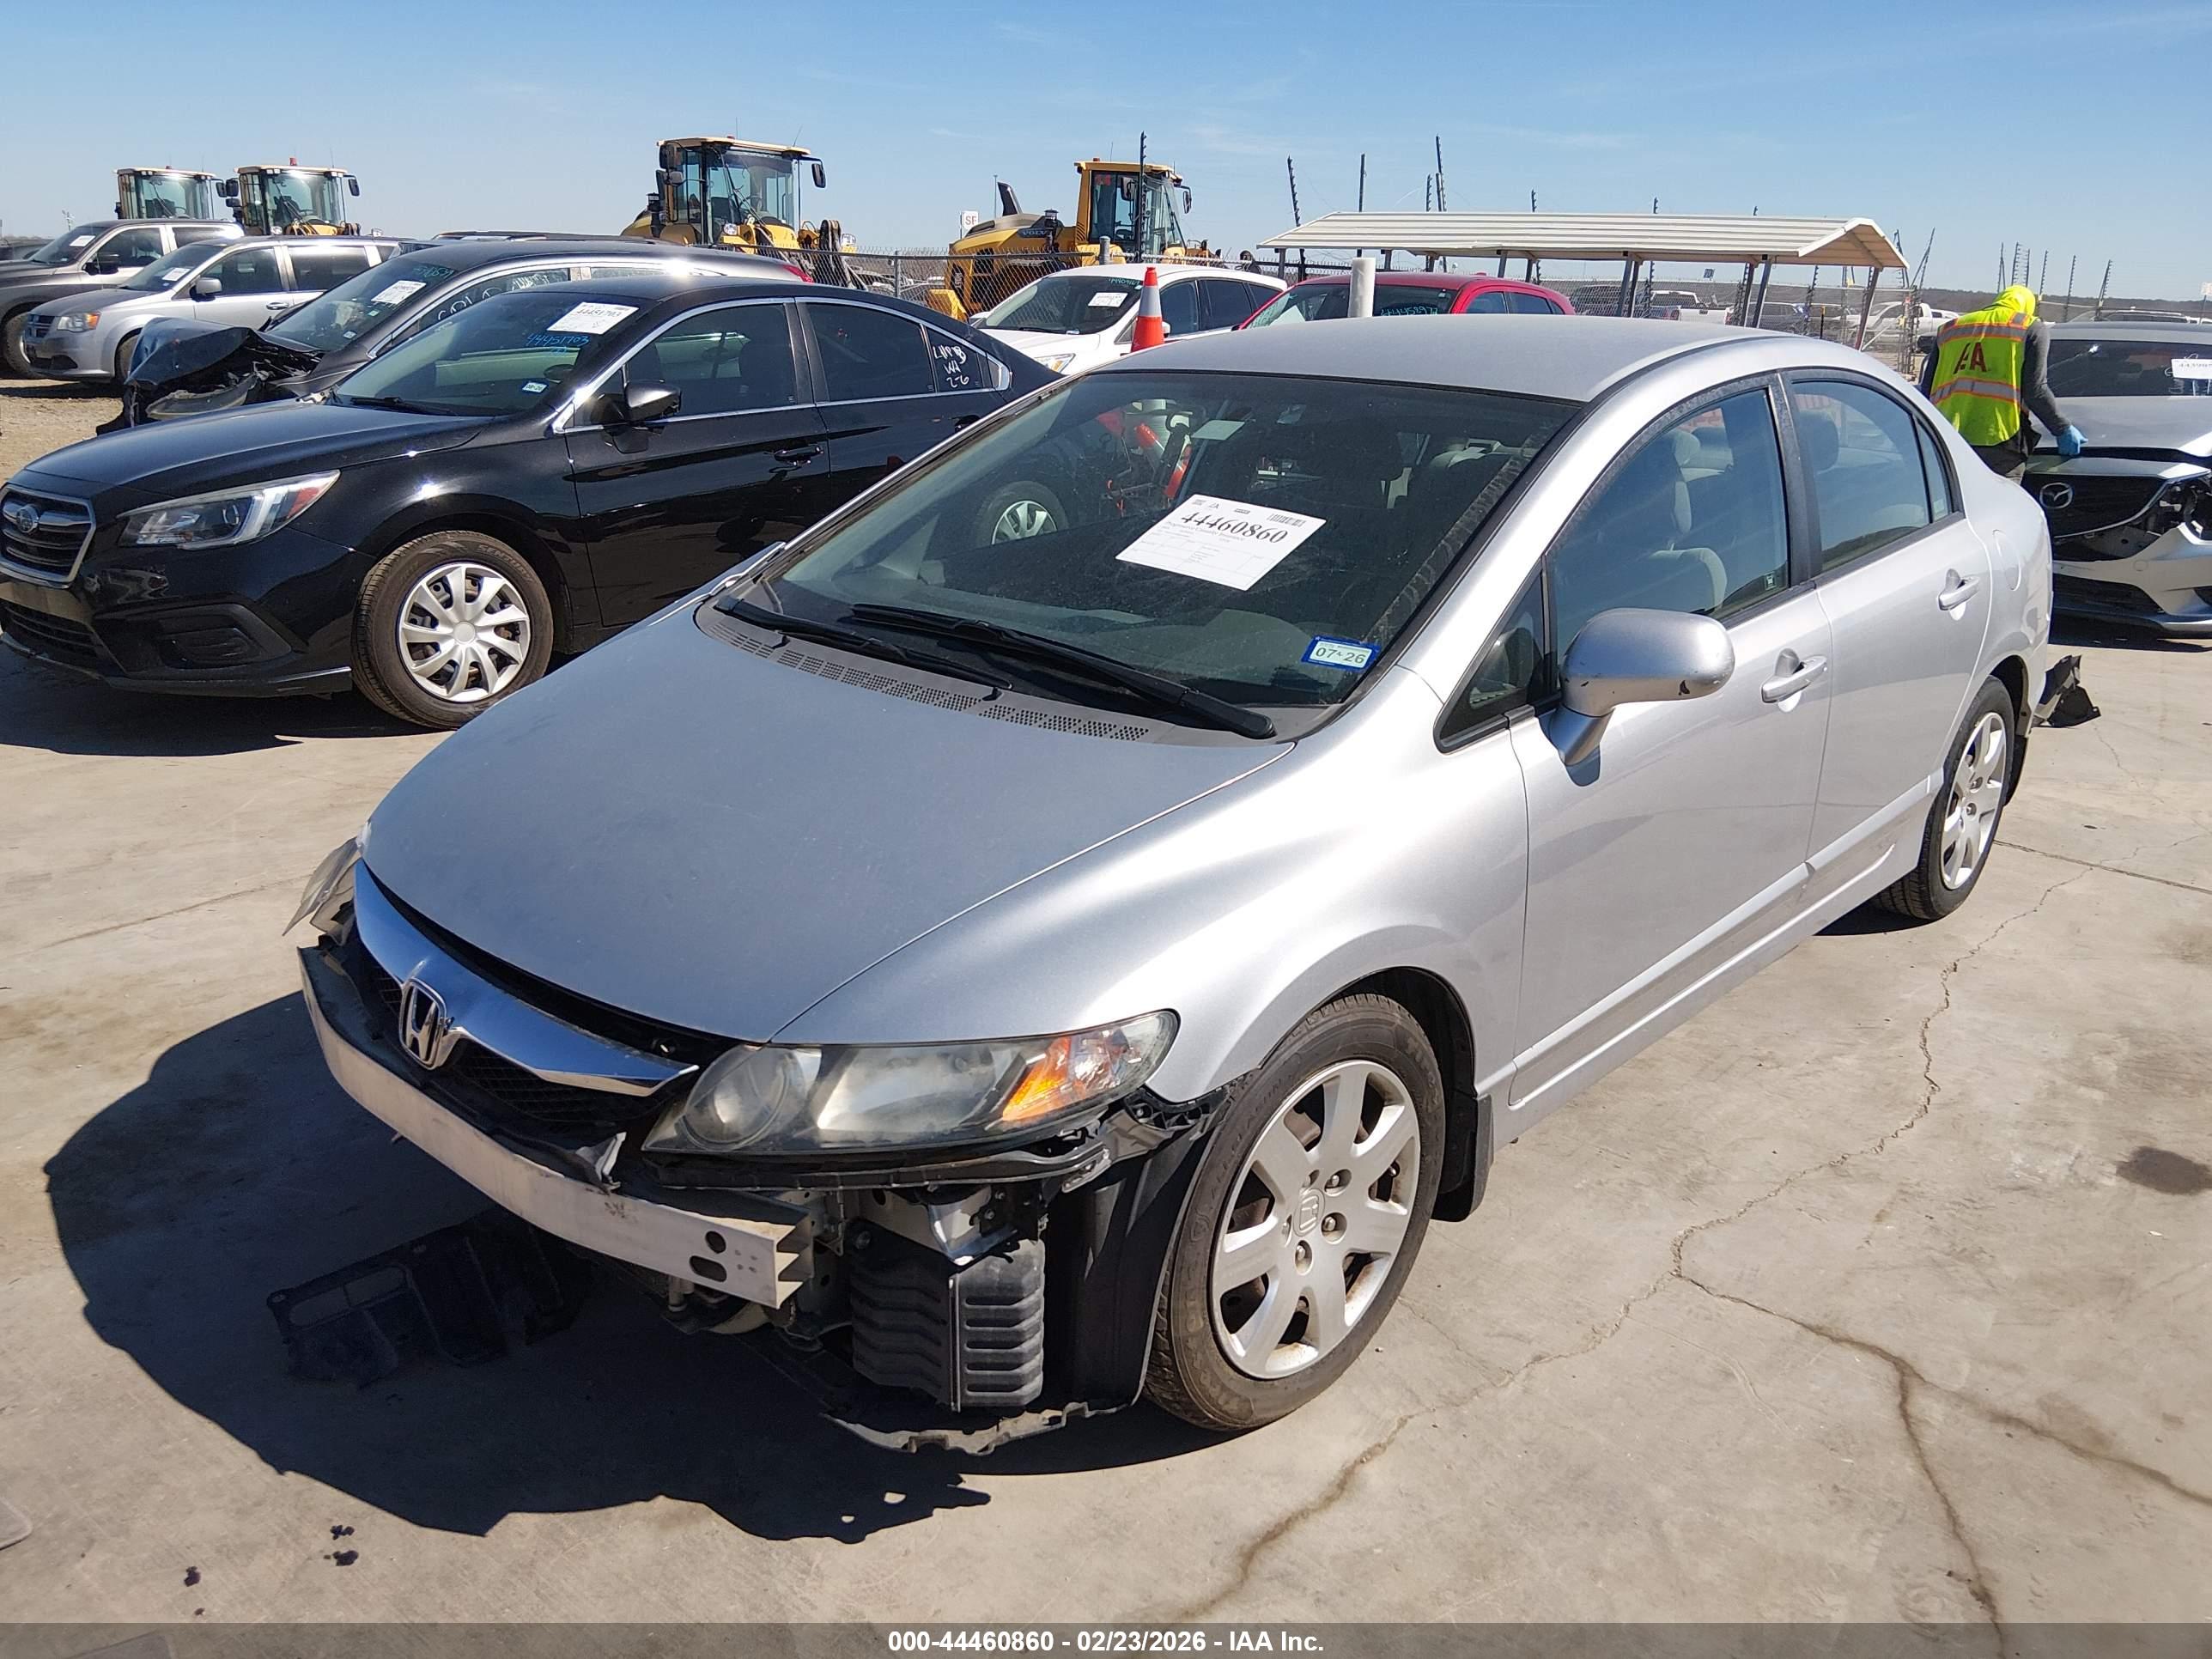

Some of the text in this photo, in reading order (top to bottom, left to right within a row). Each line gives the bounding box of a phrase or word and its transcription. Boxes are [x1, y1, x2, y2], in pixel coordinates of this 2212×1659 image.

[526, 333, 590, 347] 44451703
[946, 374, 969, 388] 2-6
[1182, 512, 1288, 543] 44460860
